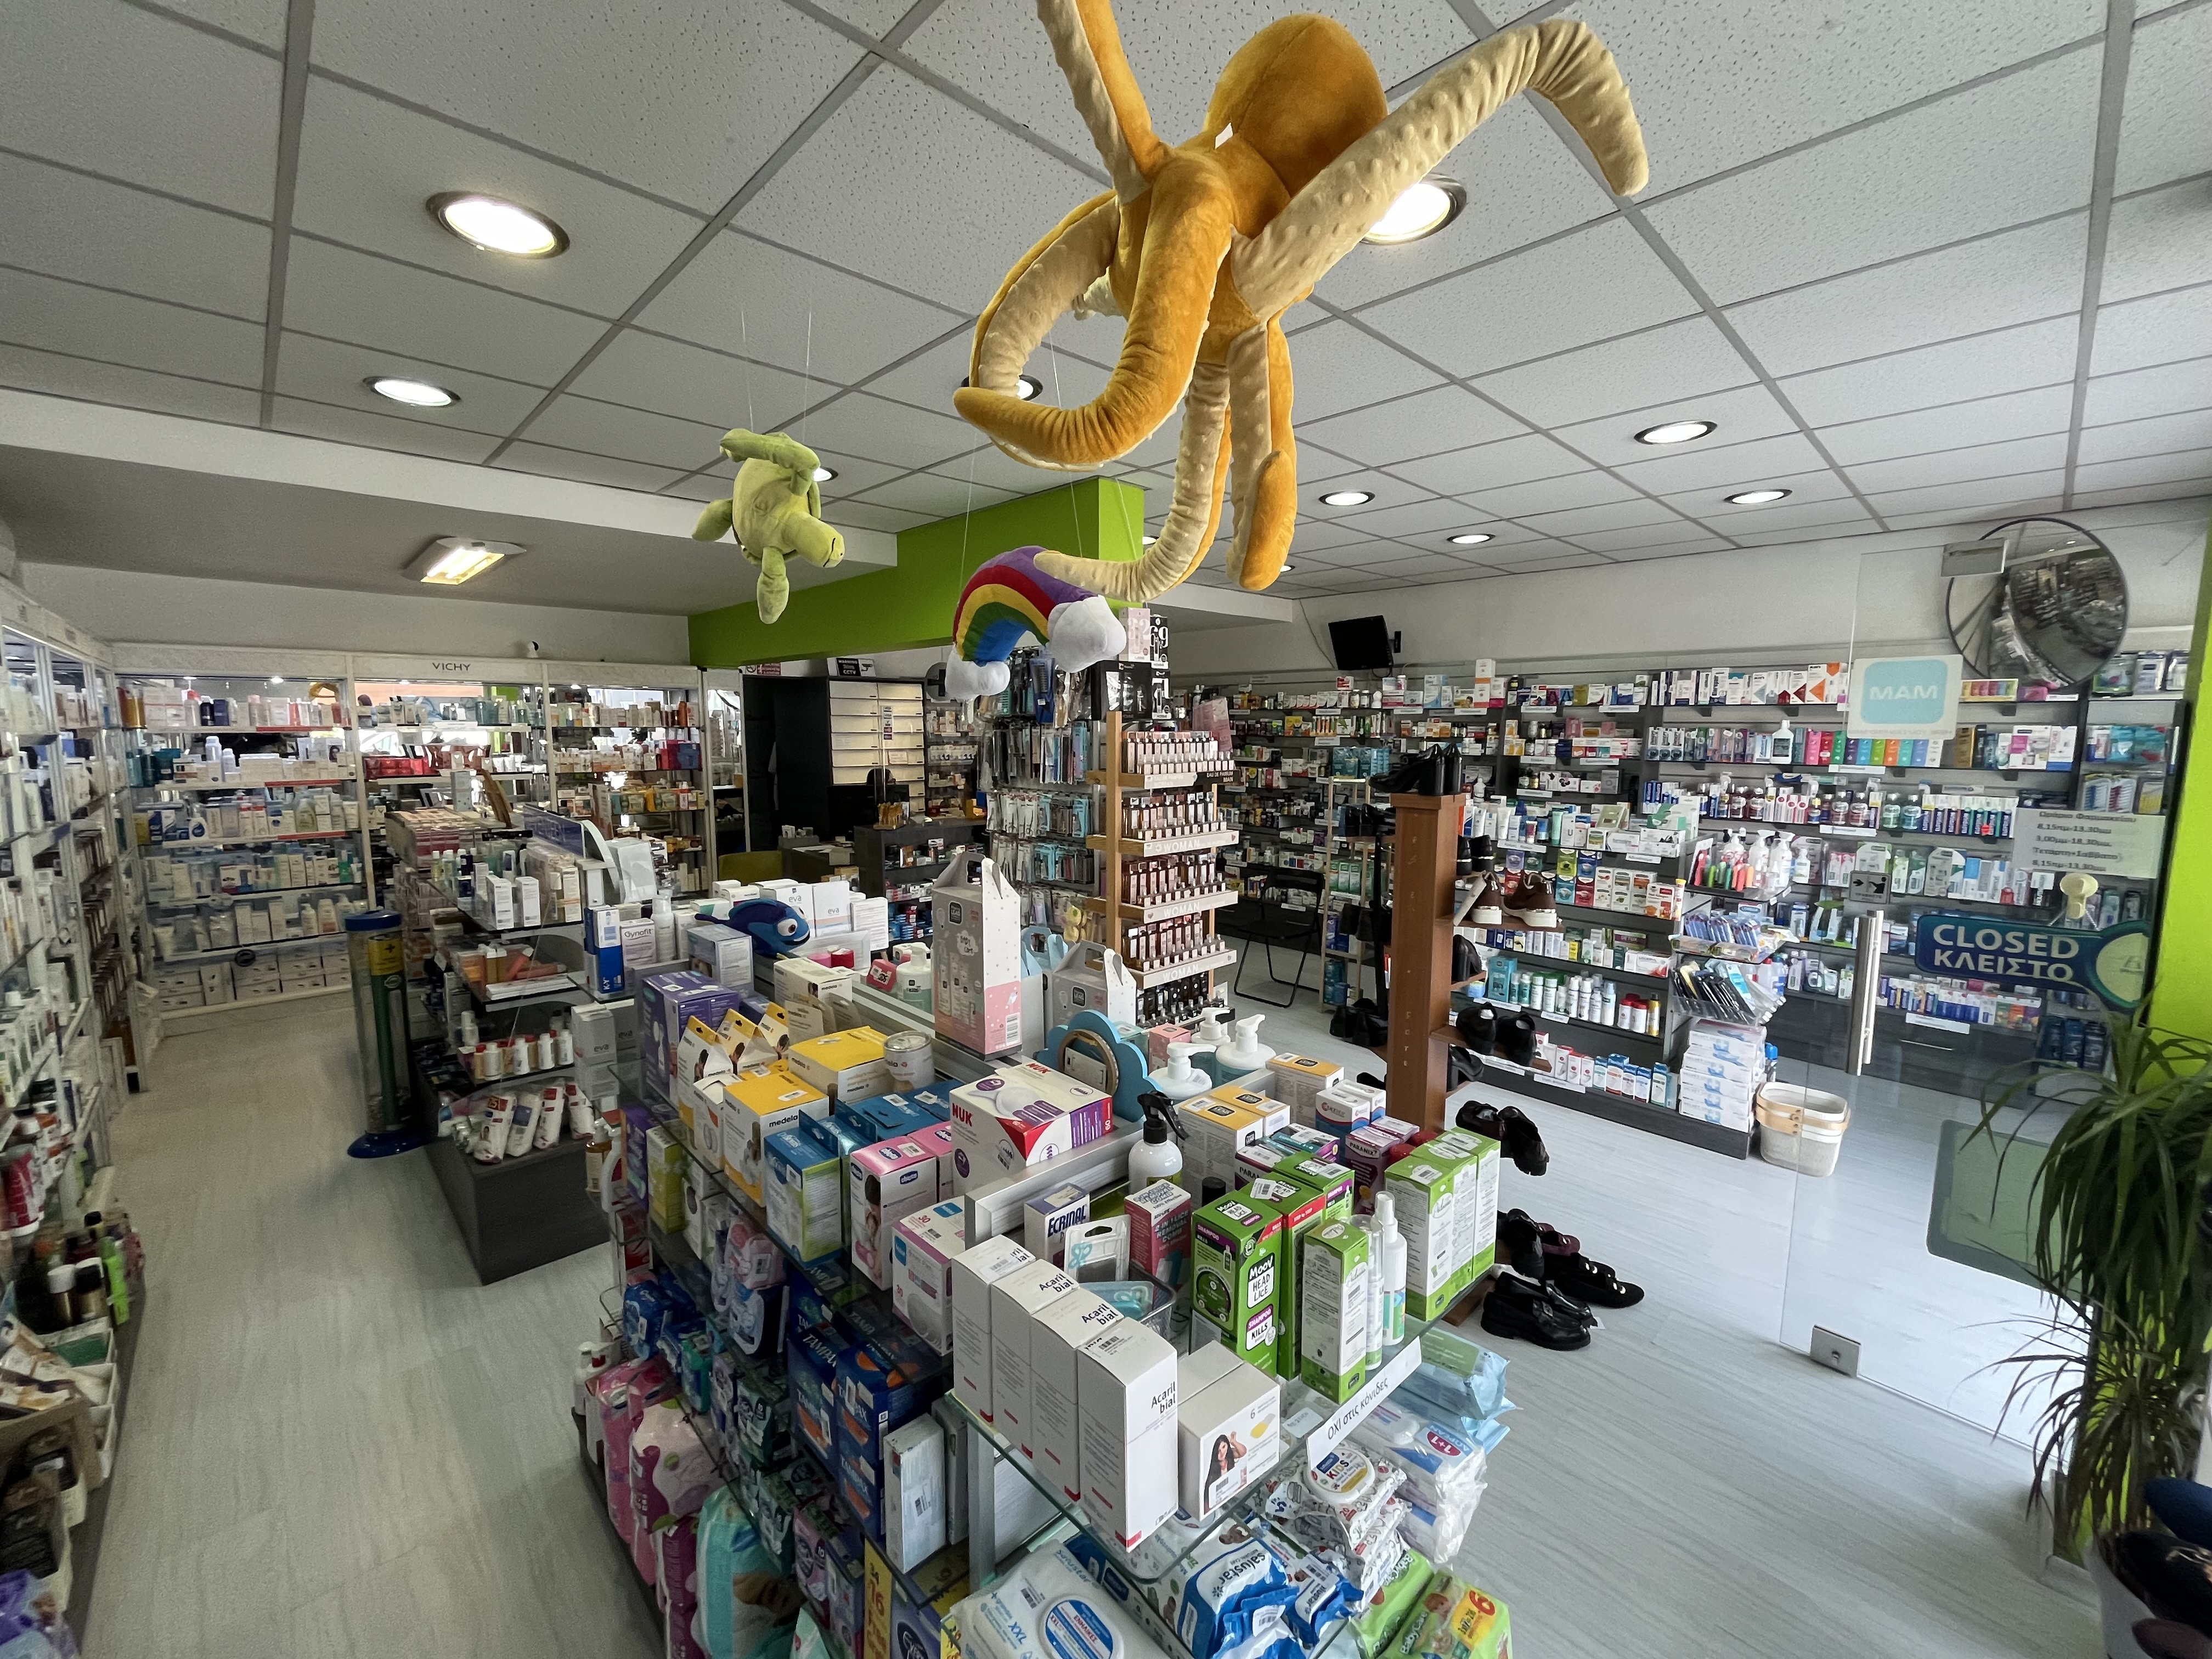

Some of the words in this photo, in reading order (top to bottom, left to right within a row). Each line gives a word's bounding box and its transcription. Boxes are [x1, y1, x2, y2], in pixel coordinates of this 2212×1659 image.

[432, 662, 471, 672] VICHY
[1869, 685, 1938, 701] MAM
[1164, 839, 1200, 852] WOMAN
[788, 895, 802, 903] eva
[1164, 902, 1200, 918] WOMAN
[624, 929, 652, 938] Gynofit
[1933, 924, 2079, 959] CLOSED
[1163, 964, 1199, 981] WOMAN
[1934, 949, 2074, 981] ΚΛΕΙΣΤΟ
[1026, 1063, 1051, 1074] NUK
[769, 1114, 798, 1128] medela
[952, 1103, 973, 1127] NUK
[1328, 1186, 1343, 1198] SHAMPOO
[918, 1215, 930, 1223] 30
[1047, 1206, 1086, 1238] ECRINAL
[1197, 1224, 1219, 1241] SHAMPOO
[1015, 1251, 1030, 1262] ial
[1039, 1273, 1066, 1290] Acaril
[1053, 1279, 1074, 1293] bial
[1253, 1274, 1270, 1293] HEAD
[1254, 1286, 1268, 1301] LICE
[1081, 1304, 1110, 1323] Acaril
[1097, 1310, 1119, 1325] bial
[1248, 1307, 1272, 1329] SHAMPOO
[1251, 1322, 1268, 1340] KILLS
[802, 1333, 837, 1367] TAMPAX
[1152, 1381, 1175, 1409] Acaril
[1361, 1378, 1388, 1409] κόνιδες
[1160, 1393, 1176, 1414] bial
[1250, 1408, 1255, 1419] 6
[1431, 1435, 1454, 1454] 1+1
[1327, 1460, 1349, 1480] KIDS
[1218, 1552, 1265, 1585] salustar
[1469, 1590, 1496, 1616] 6
[1008, 1622, 1026, 1645] XXL
[1400, 1611, 1428, 1655] BabyCare
